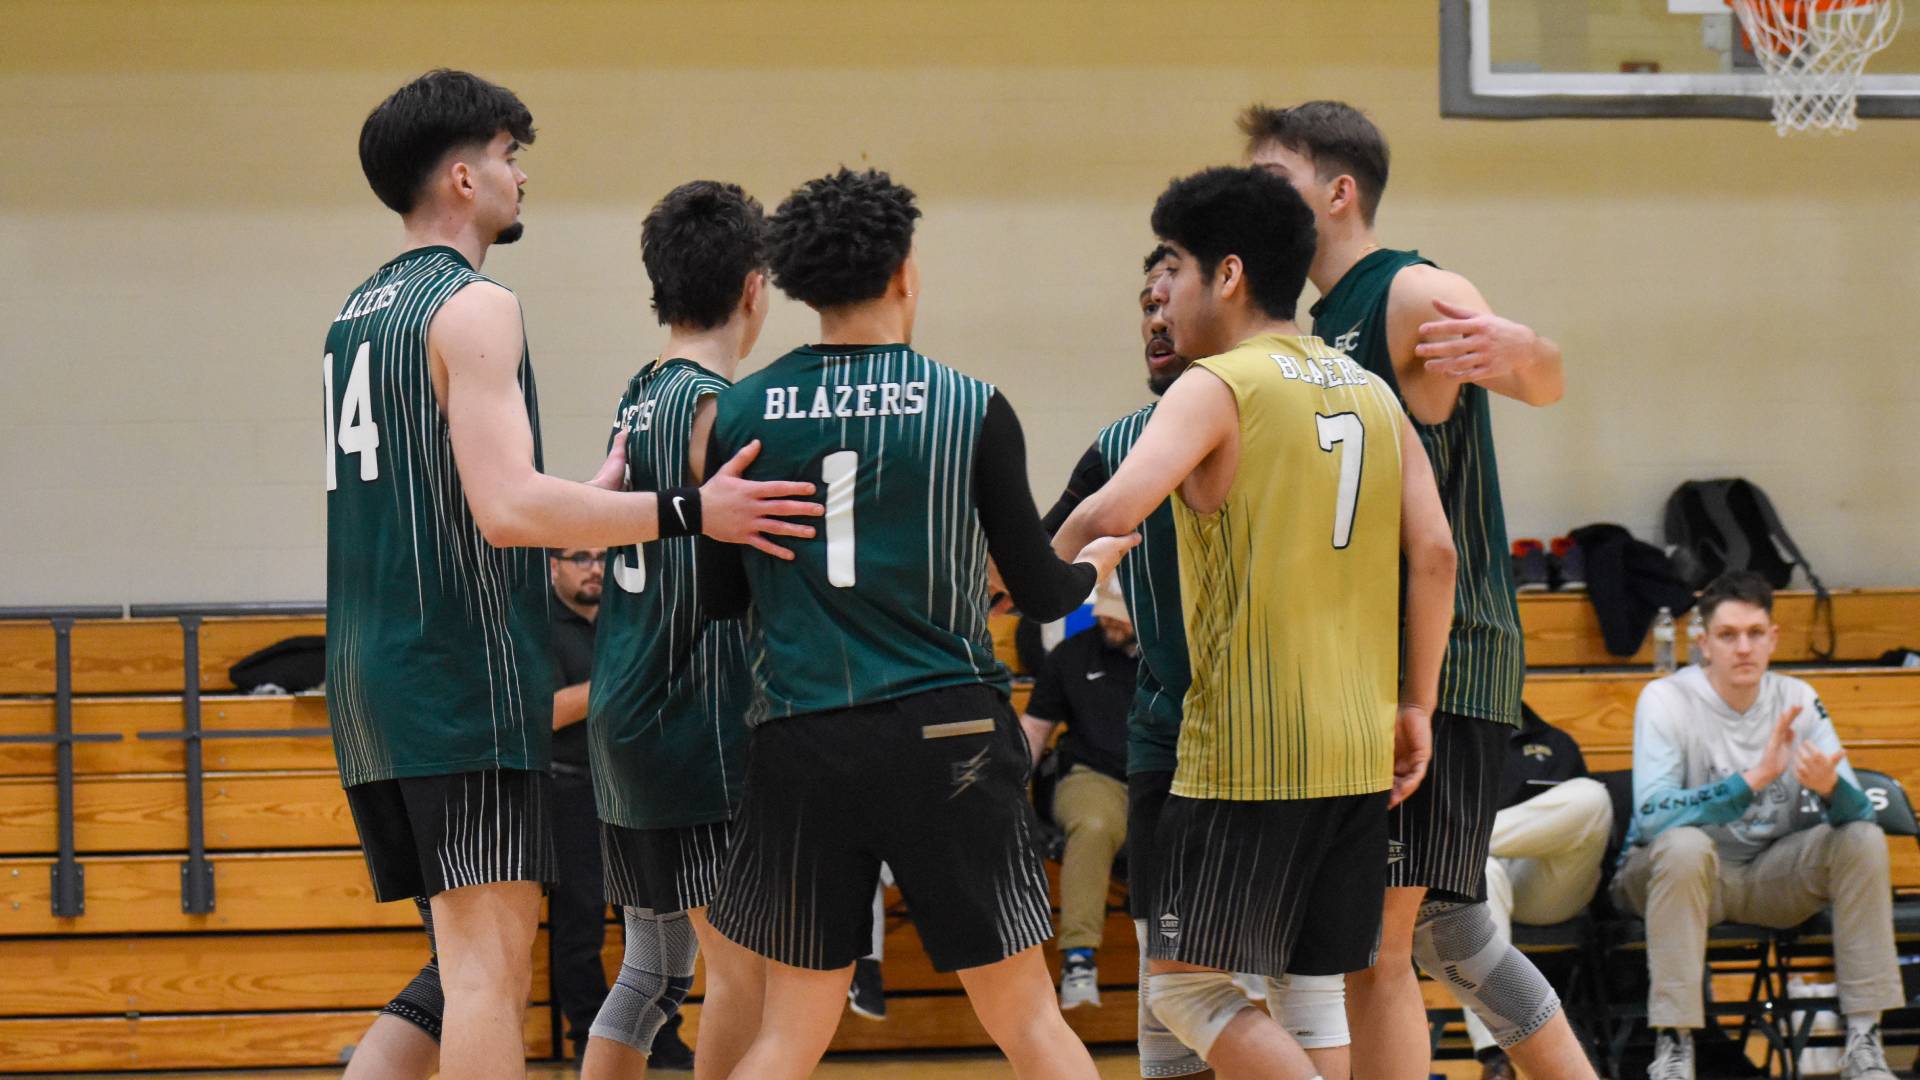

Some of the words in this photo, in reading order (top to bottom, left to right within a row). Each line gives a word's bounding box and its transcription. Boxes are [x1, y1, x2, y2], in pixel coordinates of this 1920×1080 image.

[323, 340, 380, 491] 14
[763, 381, 929, 420] BLAZERS
[821, 450, 859, 588] 1
[1315, 411, 1364, 549] 7
